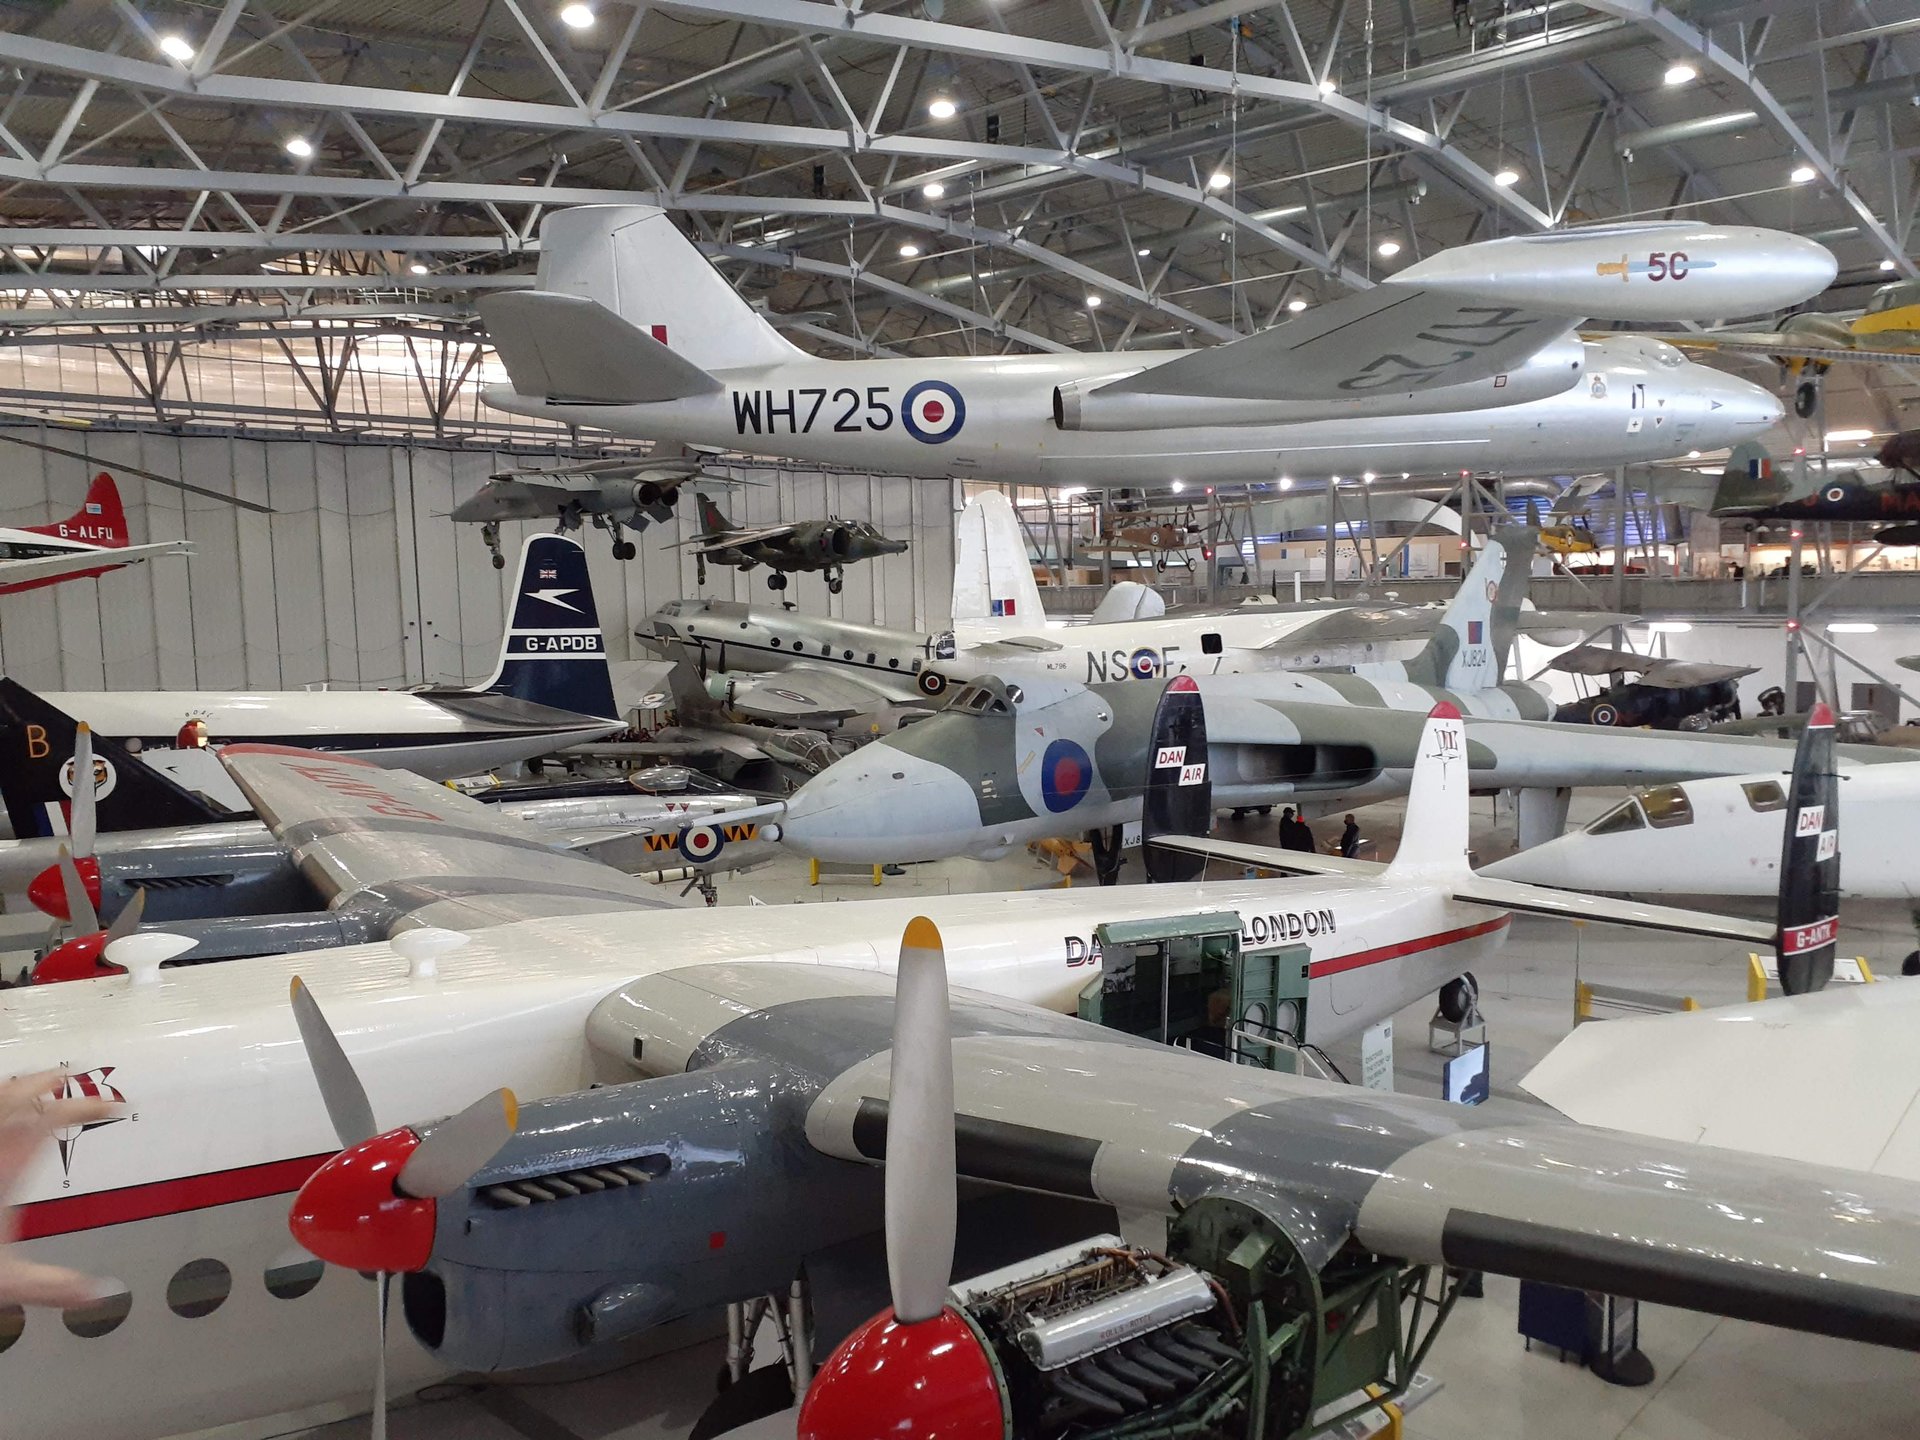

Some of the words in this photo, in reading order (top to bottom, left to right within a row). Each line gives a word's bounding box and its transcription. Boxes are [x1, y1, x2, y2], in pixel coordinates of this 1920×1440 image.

[1647, 251, 1688, 281] 5C
[732, 386, 893, 435] WH725
[59, 524, 113, 540] G-ALFU
[525, 636, 597, 651] G-APDB
[1087, 649, 1129, 683] NS
[1161, 646, 1180, 678] F
[1461, 649, 1487, 668] XJ824
[26, 723, 50, 759] B
[1159, 750, 1184, 764] DAN
[1183, 767, 1202, 781] AIR
[1800, 811, 1821, 832] DAN
[1821, 834, 1835, 852] AIR
[1242, 908, 1337, 945] LONDON
[131, 1112, 139, 1122] E
[62, 1179, 70, 1189] S
